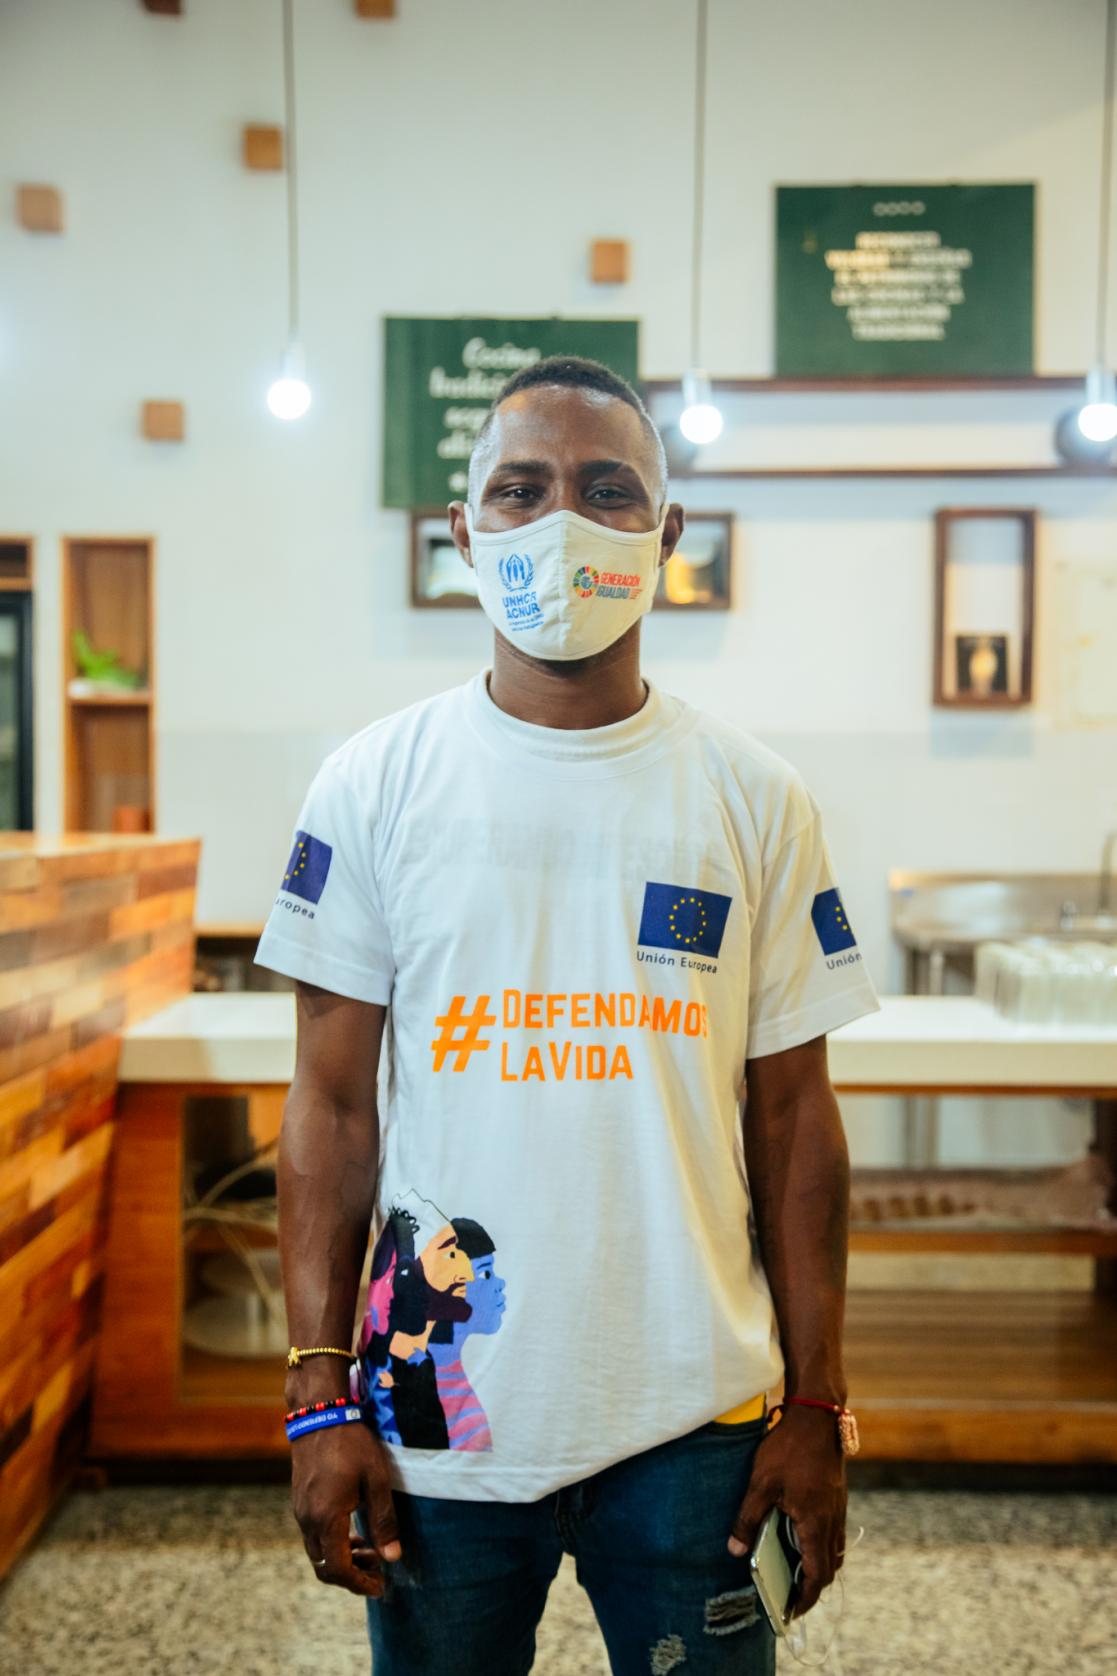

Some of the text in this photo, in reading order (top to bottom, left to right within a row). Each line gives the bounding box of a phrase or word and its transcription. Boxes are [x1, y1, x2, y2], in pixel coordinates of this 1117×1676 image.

[636, 950, 718, 974] Unión Europea
[501, 1041, 634, 1082] LAVIDA
